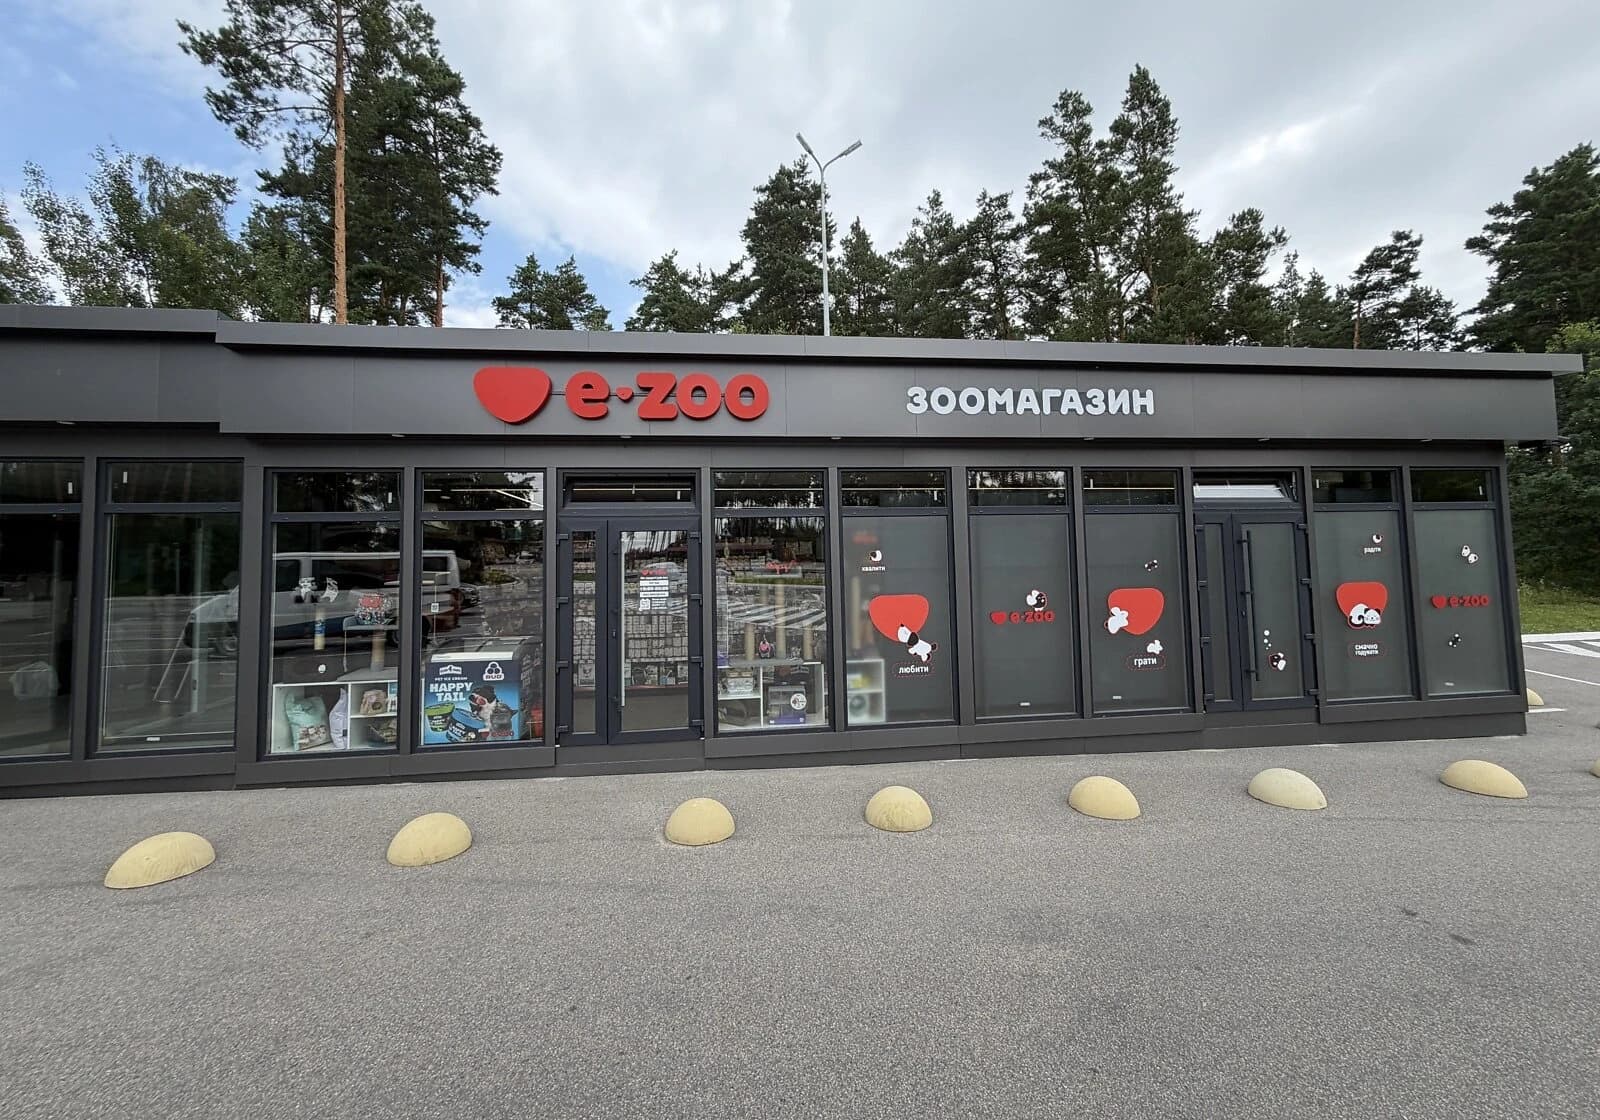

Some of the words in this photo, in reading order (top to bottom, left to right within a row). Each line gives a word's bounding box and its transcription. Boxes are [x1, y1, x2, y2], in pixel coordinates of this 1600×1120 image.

[906, 386, 1155, 416] ЗООМАГАЗИН
[1133, 657, 1157, 668] грати
[898, 664, 929, 674] любити
[429, 682, 473, 693] HAPPY
[436, 692, 466, 702] TAIL
